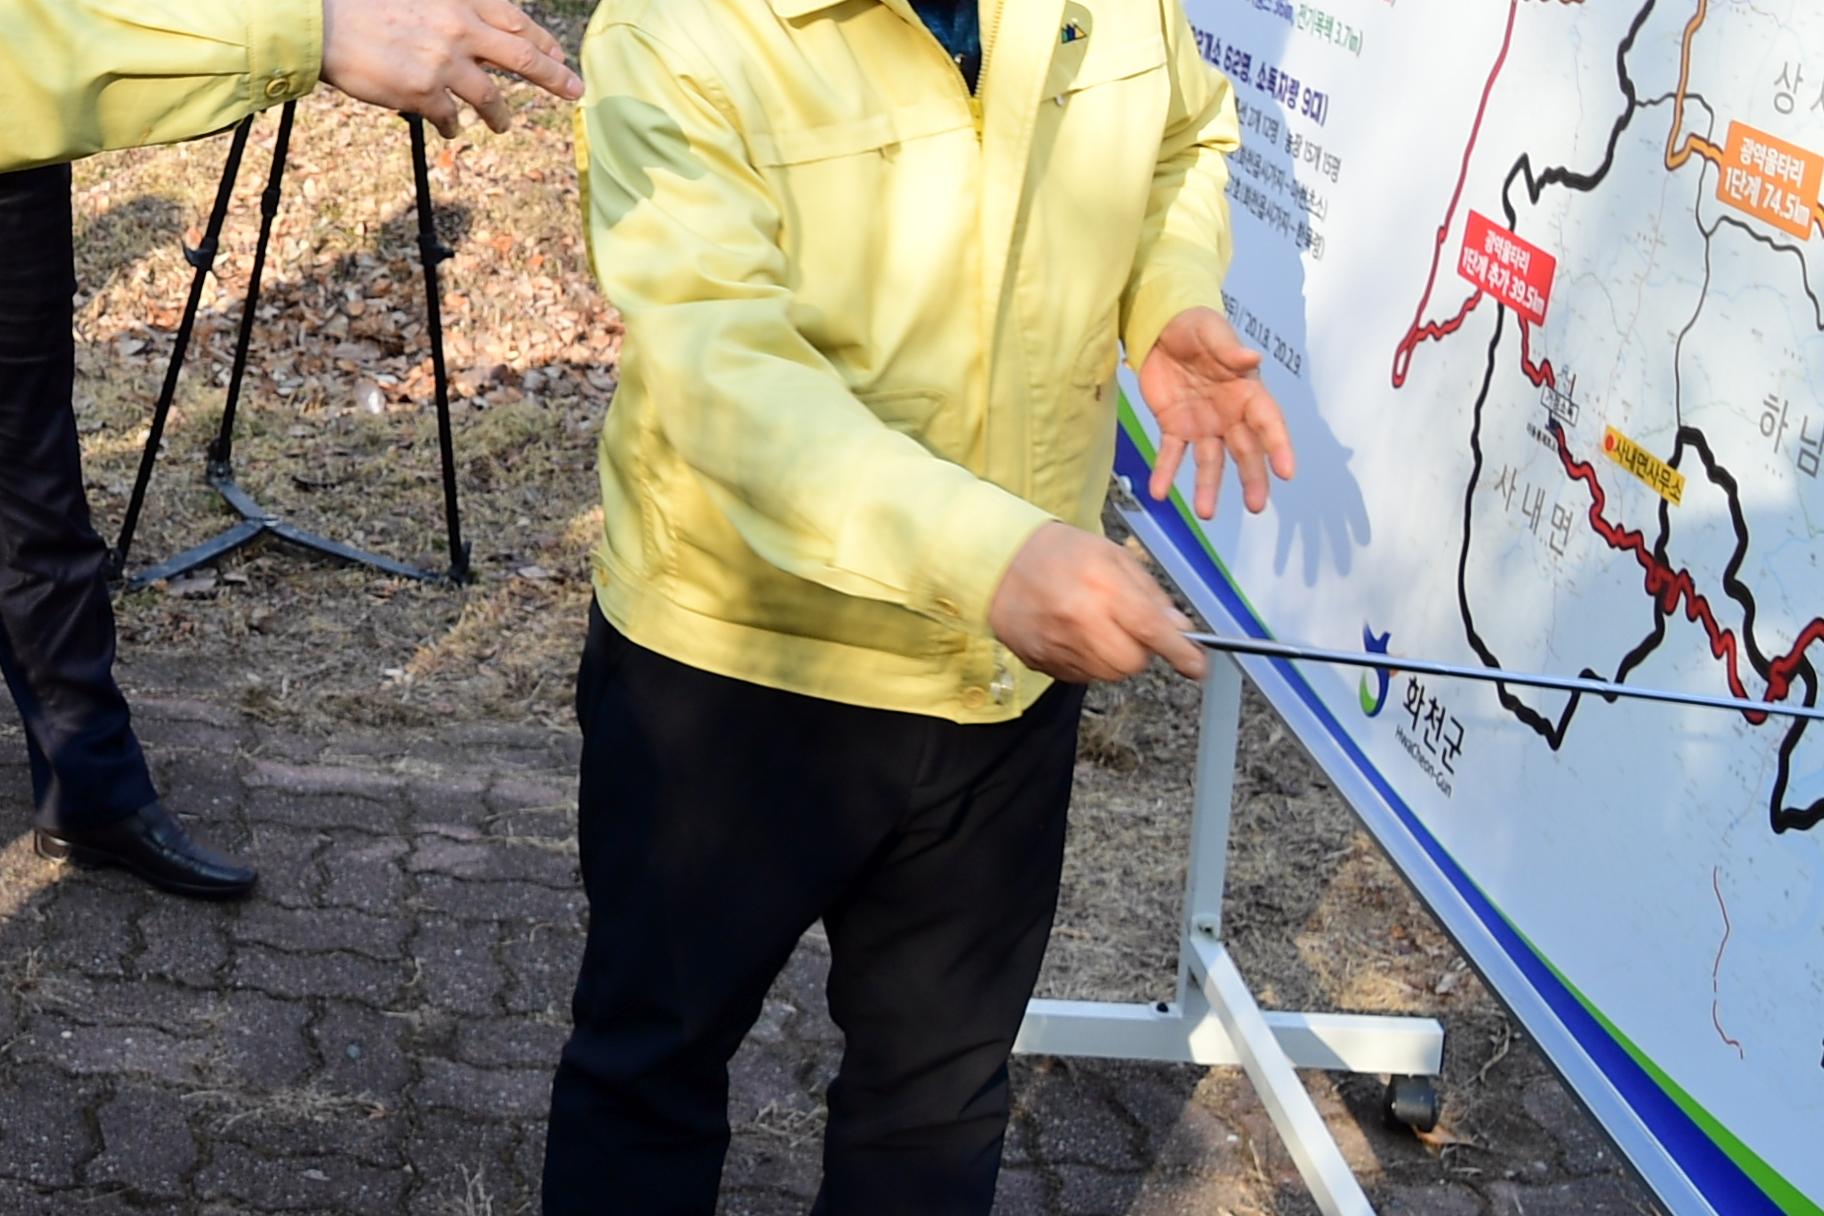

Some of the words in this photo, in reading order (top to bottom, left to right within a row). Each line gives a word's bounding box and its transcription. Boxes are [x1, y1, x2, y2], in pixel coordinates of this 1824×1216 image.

[1724, 165, 1763, 209] 1단계
[1739, 136, 1805, 189] 광역울타리
[1486, 261, 1512, 298] 추가
[1614, 439, 1681, 502] 사내면사무소
[1493, 464, 1574, 557] 사내면
[1402, 674, 1465, 775] 화천군
